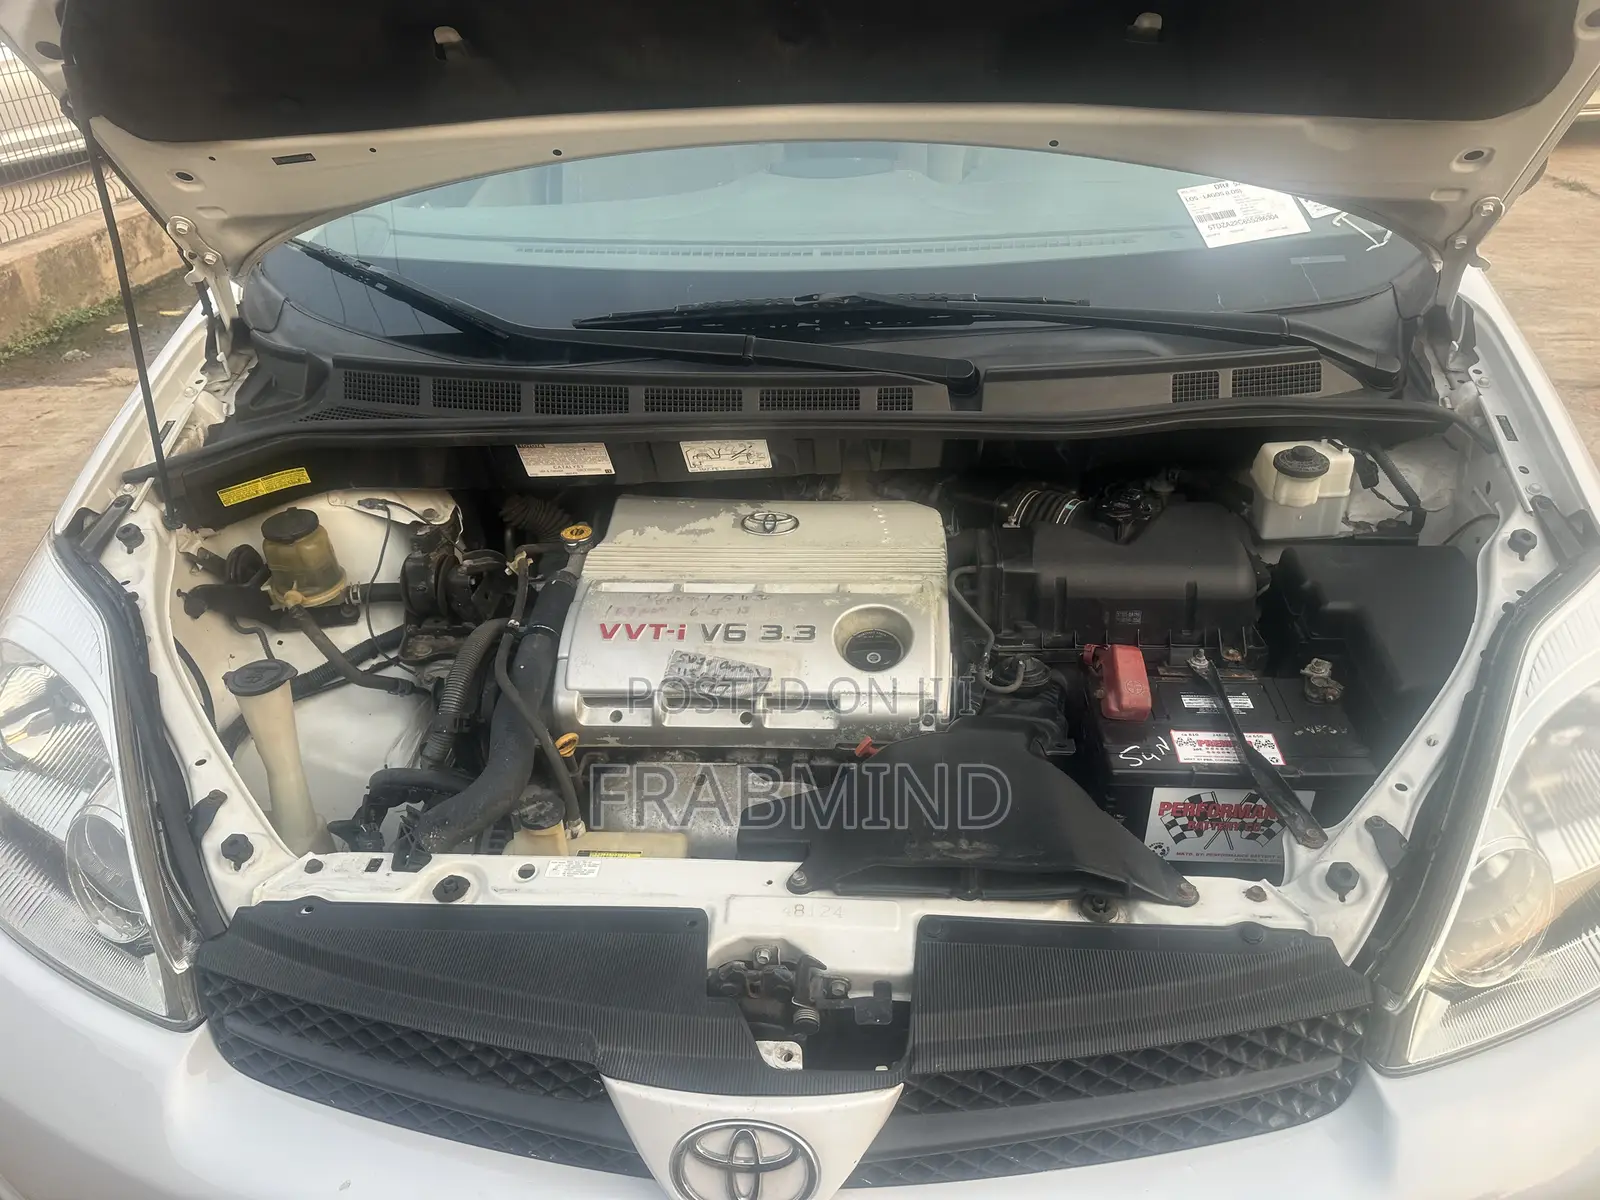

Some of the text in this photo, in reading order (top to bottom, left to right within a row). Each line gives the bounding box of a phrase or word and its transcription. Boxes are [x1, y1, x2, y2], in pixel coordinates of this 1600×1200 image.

[1202, 191, 1225, 200] LAGOS
[600, 623, 816, 642] VVT-i V6 3.3
[1158, 802, 1280, 819] PERFORMAN
[1187, 821, 1241, 831] BATTERY
